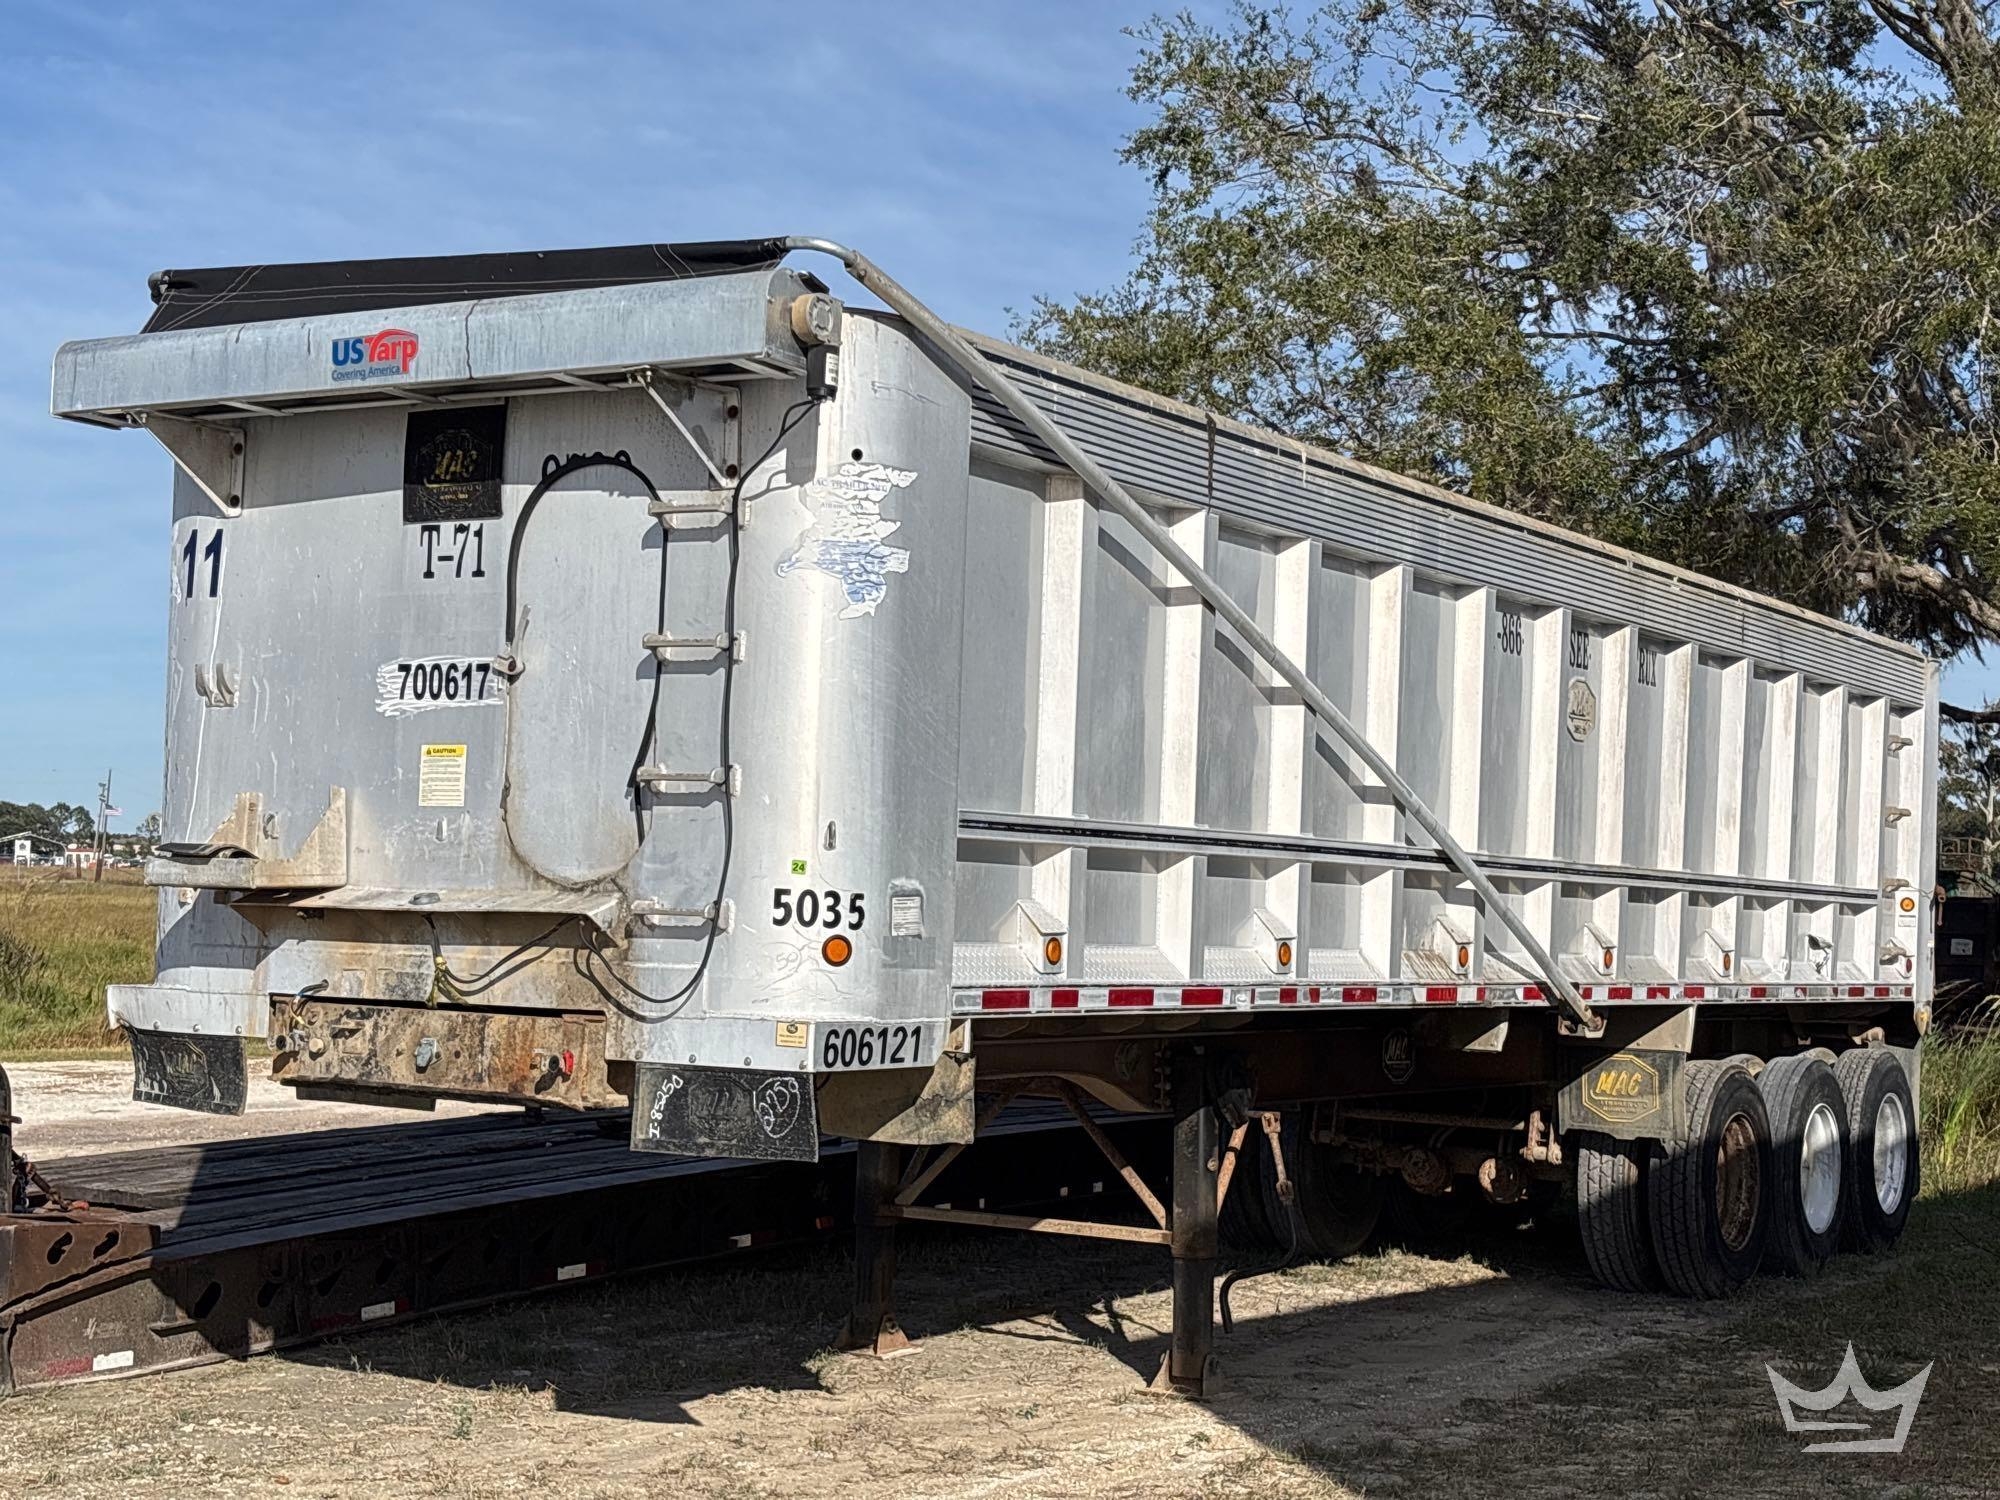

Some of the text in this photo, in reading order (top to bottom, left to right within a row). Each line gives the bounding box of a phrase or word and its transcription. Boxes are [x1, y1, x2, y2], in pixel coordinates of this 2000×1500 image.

[331, 364, 400, 381] Covering America
[183, 528, 224, 598] 11
[420, 523, 486, 579] T-71
[397, 662, 491, 701] 700617
[1637, 647, 1657, 687] RUX
[793, 862, 805, 872] 24
[772, 888, 866, 931] 5035
[823, 1025, 922, 1069] 606121
[1596, 1070, 1642, 1096] MAC
